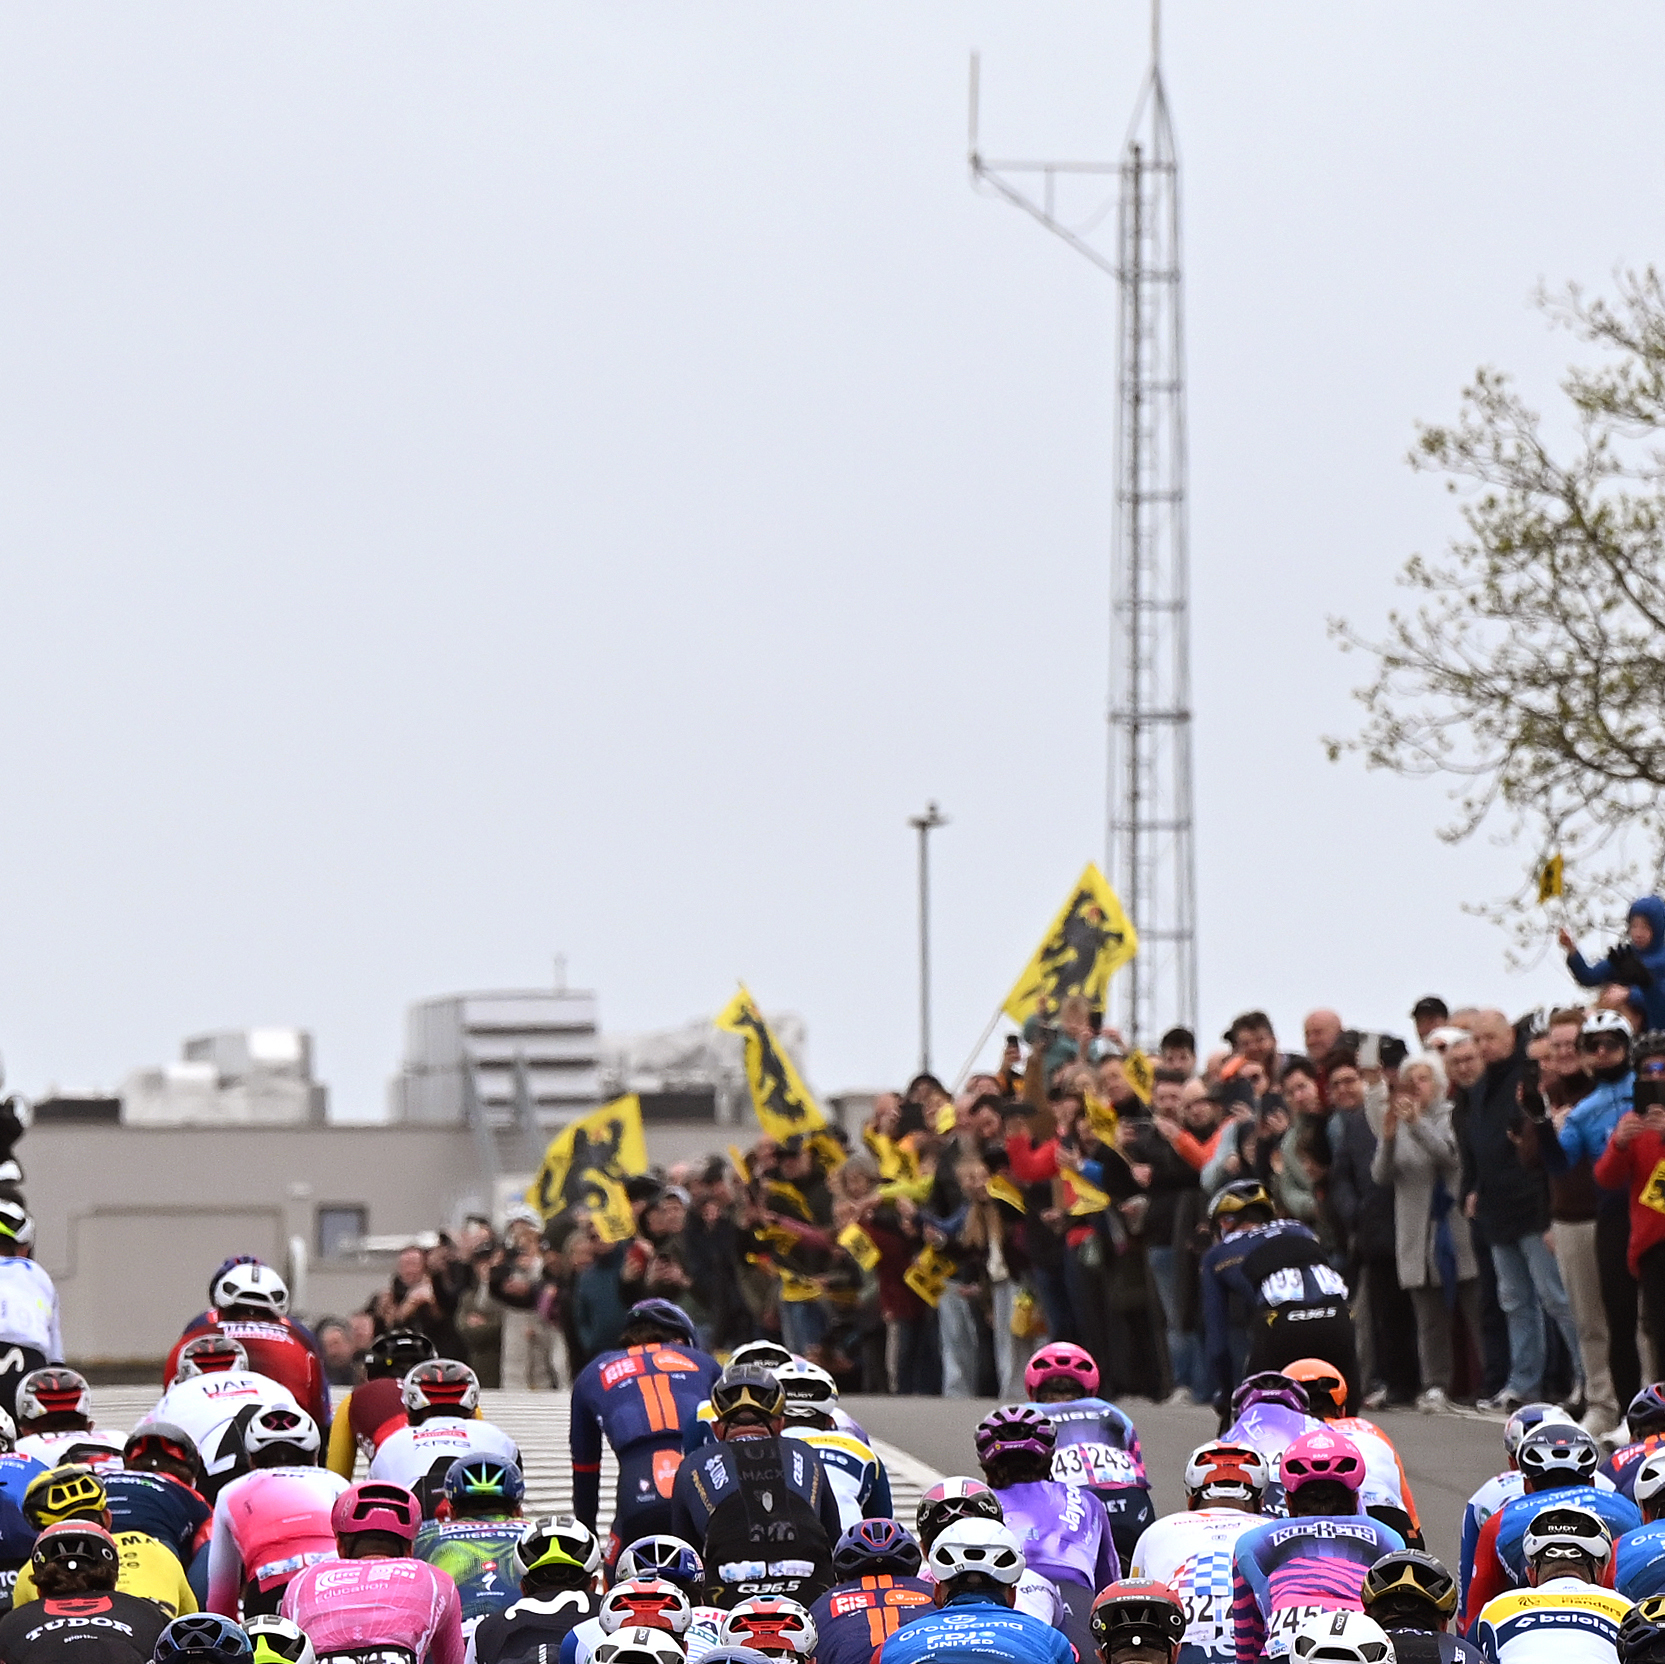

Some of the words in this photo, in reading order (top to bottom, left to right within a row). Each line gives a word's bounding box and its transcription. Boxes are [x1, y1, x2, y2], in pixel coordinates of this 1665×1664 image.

[1050, 1409, 1112, 1423] NIBET
[1053, 1449, 1083, 1475] 43
[1092, 1443, 1132, 1470] 243
[1058, 1485, 1085, 1531] Jayco
[1268, 1521, 1378, 1548] ROCKETS
[738, 1580, 801, 1593] Q36.5
[25, 1617, 133, 1638] TUDOR
[898, 1617, 1024, 1642] Groupama
[927, 1632, 971, 1643] FDJ
[927, 1640, 994, 1649] UNITED
